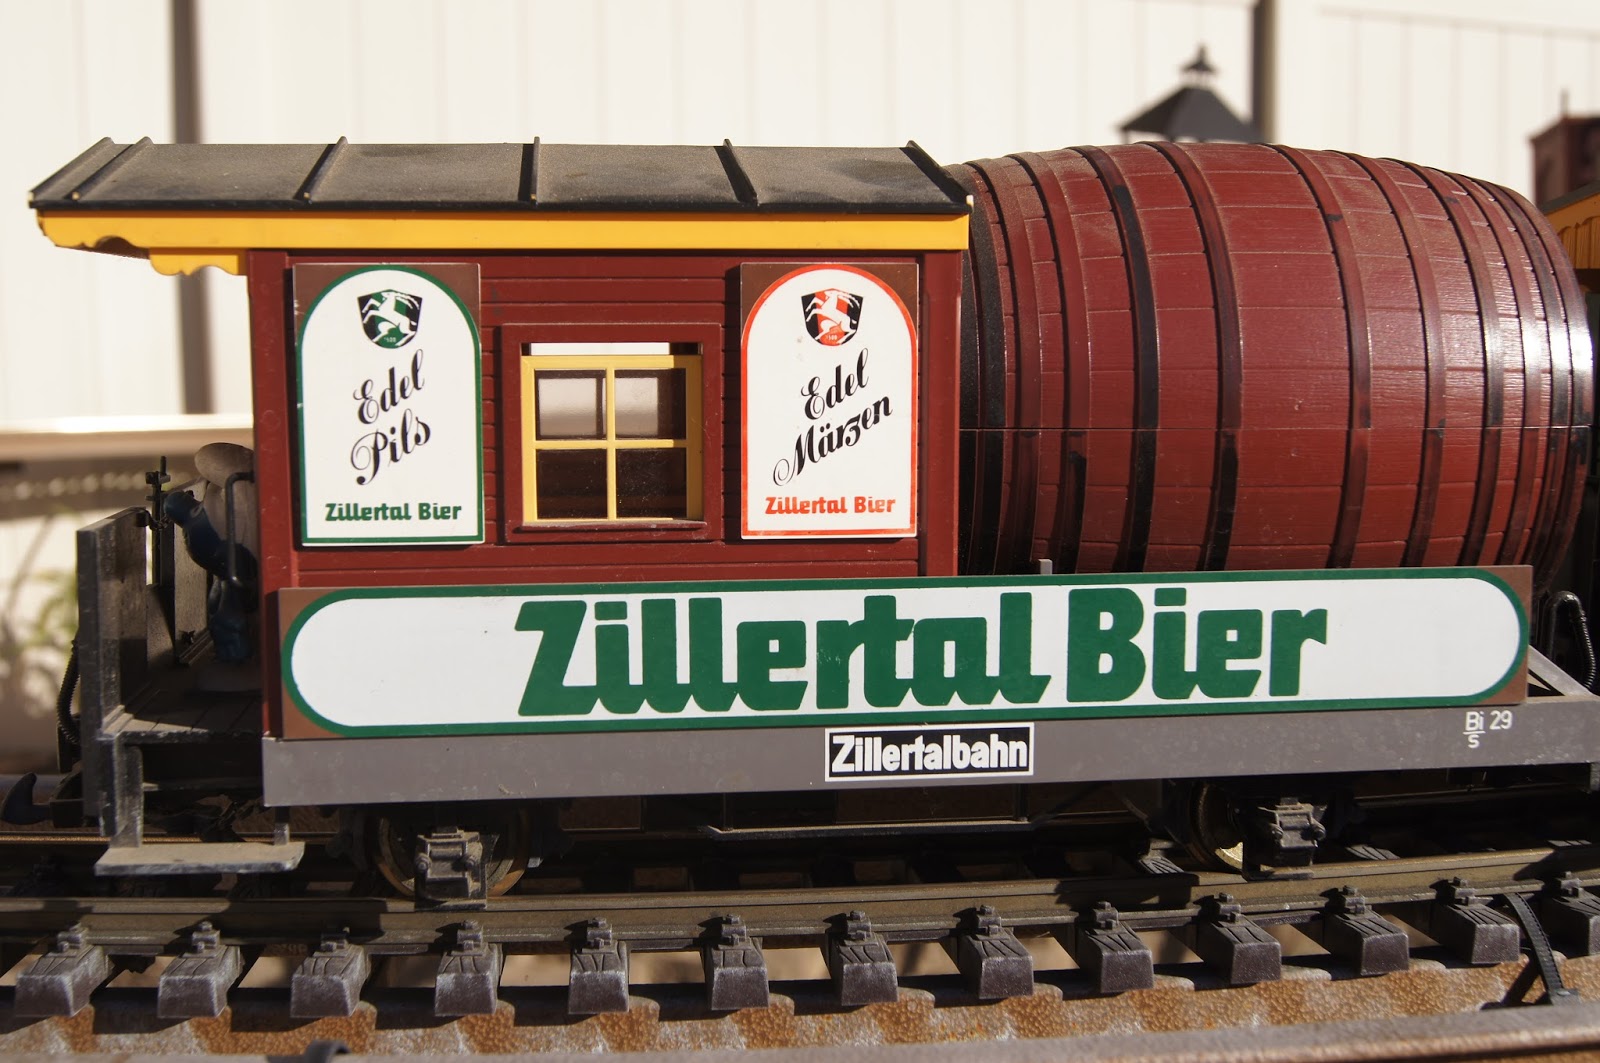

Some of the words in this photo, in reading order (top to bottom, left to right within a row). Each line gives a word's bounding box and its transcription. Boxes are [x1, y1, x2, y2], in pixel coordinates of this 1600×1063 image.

[353, 349, 425, 425] Edel
[801, 348, 869, 420] Edel
[350, 408, 431, 486] Pils
[773, 396, 893, 486] Märzen
[325, 503, 412, 522] Zillertal
[418, 503, 462, 521] Bier
[765, 496, 848, 515] Zillertal
[854, 496, 896, 514] Bier
[514, 592, 1052, 717] Zillertal
[1067, 588, 1328, 703] Bier
[832, 733, 1028, 773] Zillertalbahn
[1465, 711, 1485, 731] Bi
[1489, 710, 1513, 730] 29
